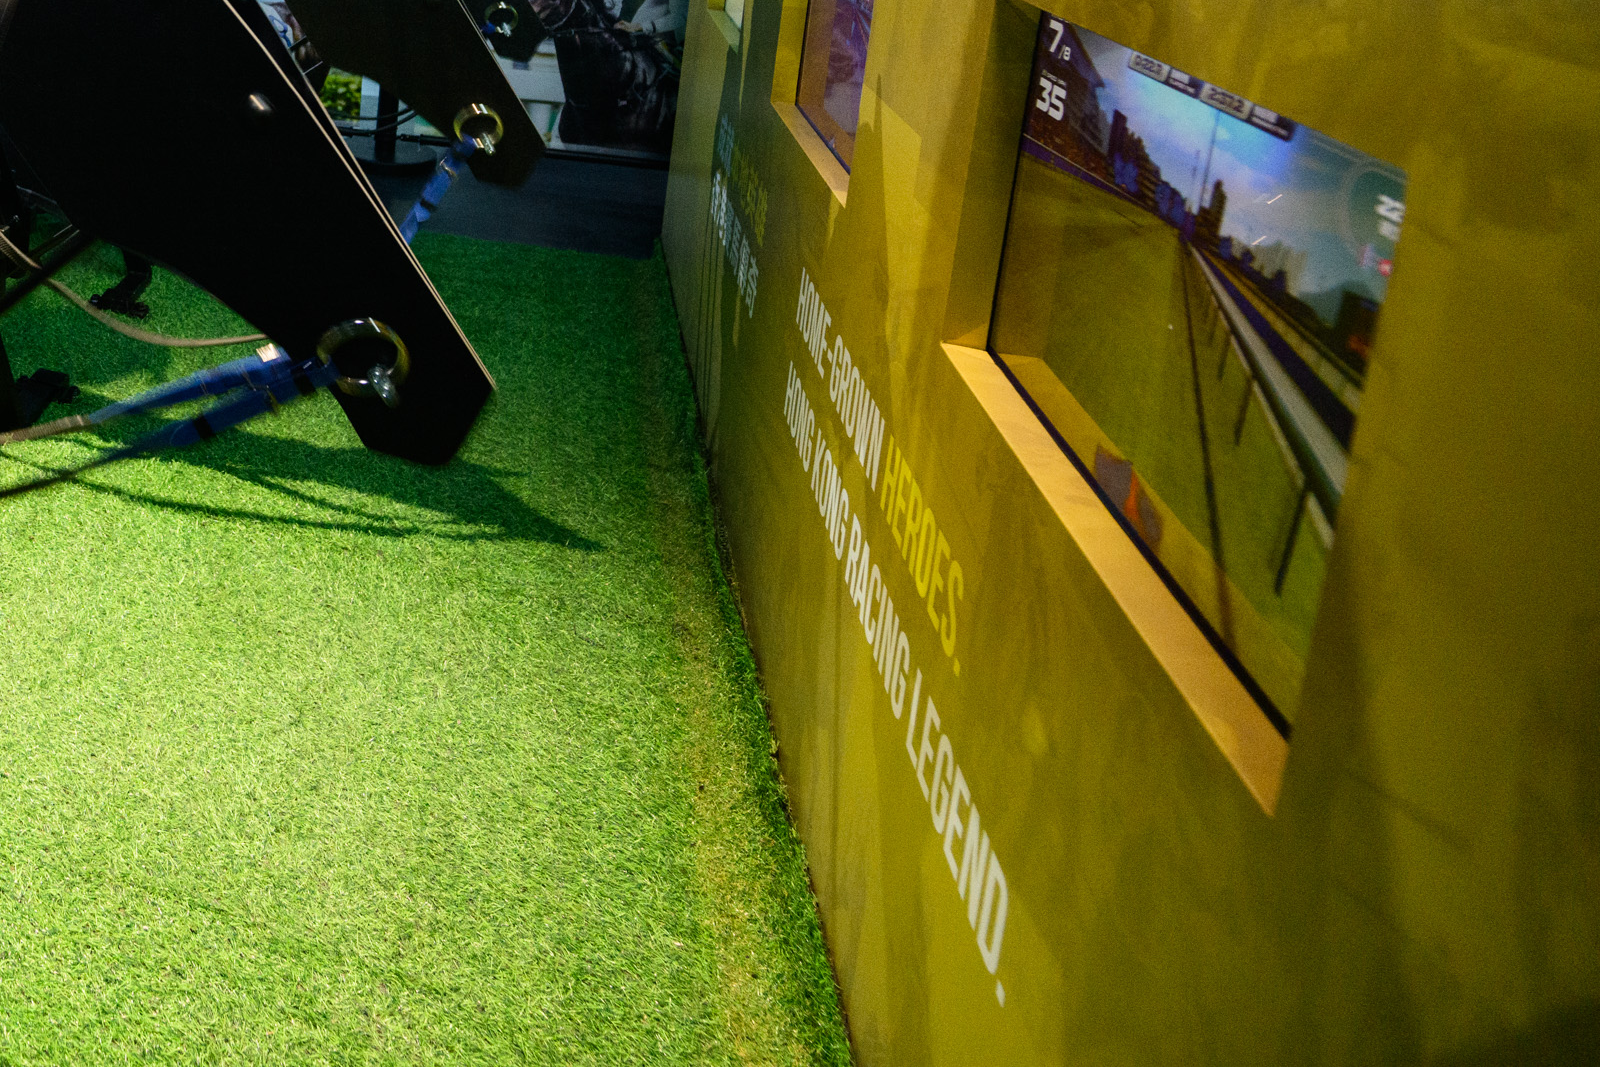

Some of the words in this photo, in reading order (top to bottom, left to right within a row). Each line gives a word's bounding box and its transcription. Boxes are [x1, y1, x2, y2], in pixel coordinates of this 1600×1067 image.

[1036, 76, 1067, 121] 35
[796, 266, 886, 493] HOME-GROWN
[880, 433, 964, 677] HEROES.
[783, 360, 815, 473] HONG
[810, 428, 849, 561] KONG
[844, 512, 910, 720] RACING
[906, 667, 1009, 1008] LEGEND.
